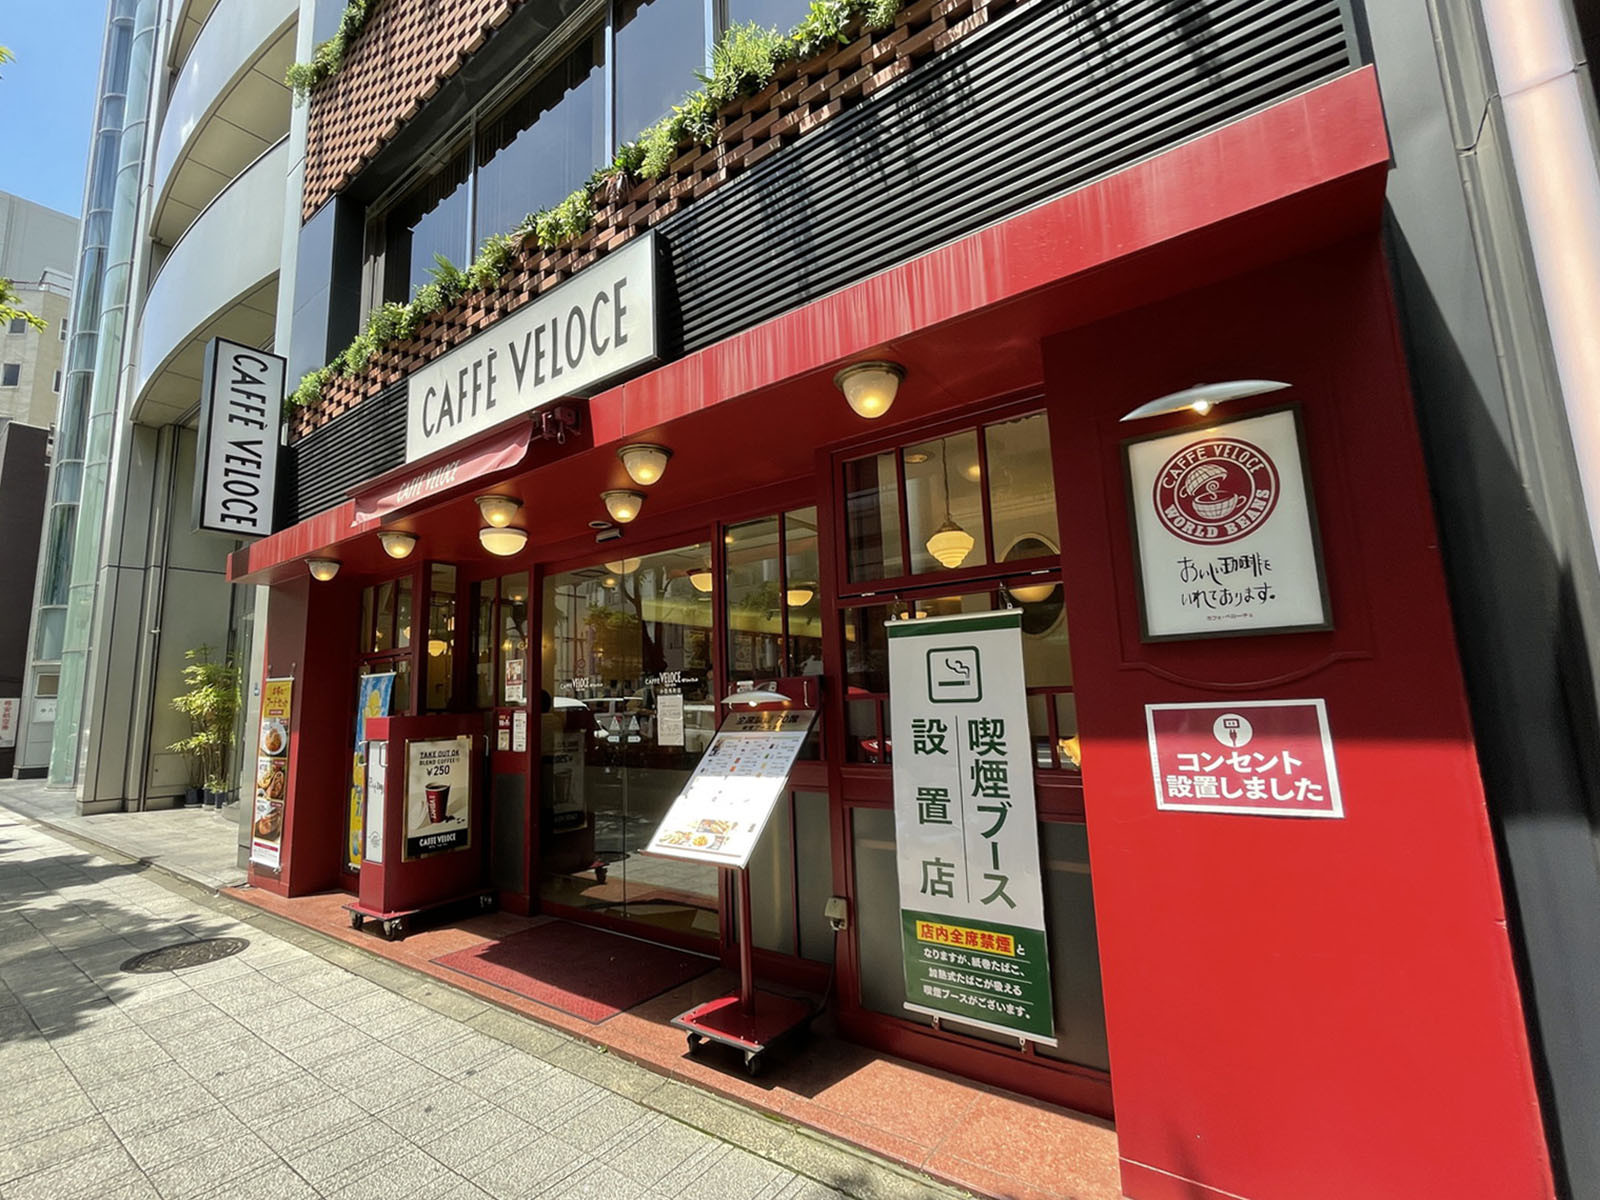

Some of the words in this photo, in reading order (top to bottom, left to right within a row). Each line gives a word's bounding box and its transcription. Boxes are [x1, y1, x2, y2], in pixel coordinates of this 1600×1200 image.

[422, 348, 498, 438] CAFFÈ
[509, 277, 628, 394] VELOCE
[228, 354, 269, 431] CAFFÈ
[1213, 444, 1265, 474] VELOCE
[220, 440, 263, 527] VELOCE
[1164, 504, 1219, 538] WORLD
[1226, 488, 1270, 536] BEANS
[1181, 582, 1276, 609] いれております。
[572, 677, 590, 688] VELOCE
[659, 671, 681, 684] VELOCE
[420, 751, 436, 759] TAKE
[437, 757, 455, 765] COFFEE
[1177, 751, 1303, 775] コンセント
[1166, 775, 1324, 801] 設置しました
[911, 718, 955, 898] 設置店
[966, 717, 1016, 909] 喫煙ブース
[437, 833, 456, 844] VELOCE
[928, 967, 1022, 996] 加熱式たばこが吸える
[923, 984, 1031, 1019] 喫煙ブースがございます。
